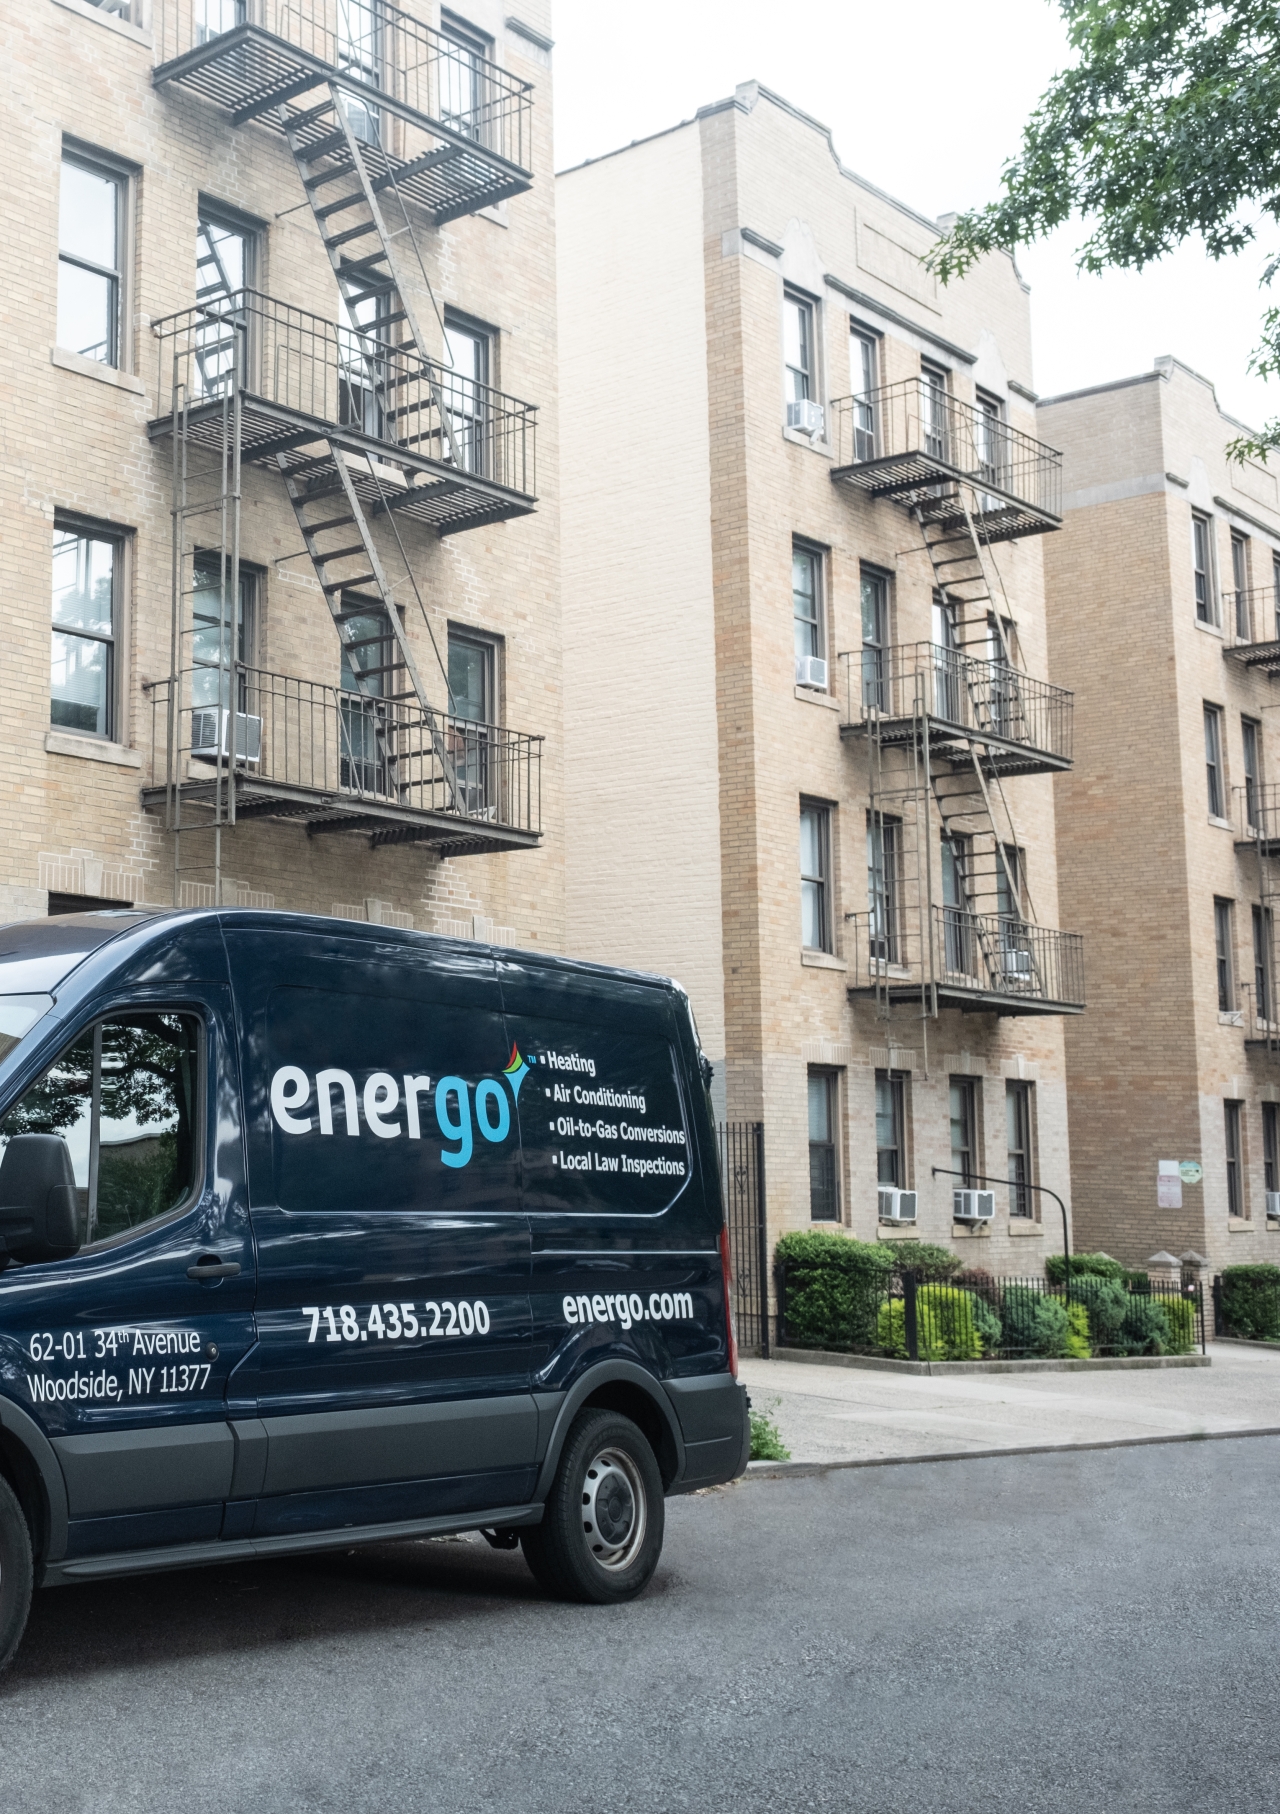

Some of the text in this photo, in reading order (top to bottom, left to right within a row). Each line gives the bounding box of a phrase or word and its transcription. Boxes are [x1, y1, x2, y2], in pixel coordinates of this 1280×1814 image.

[547, 1050, 596, 1077] Heating
[553, 1083, 647, 1114] Air Conditioning
[270, 1065, 511, 1168] energo
[556, 1116, 686, 1145] Oil-to-Gas Conversions
[560, 1150, 686, 1178] Local Law Inspections
[302, 1300, 491, 1343] 718.435.2200
[562, 1292, 694, 1330] energo.com
[29, 1329, 201, 1362] 62-01 34th Avenue
[26, 1363, 212, 1403] Woodside, NY 11377
